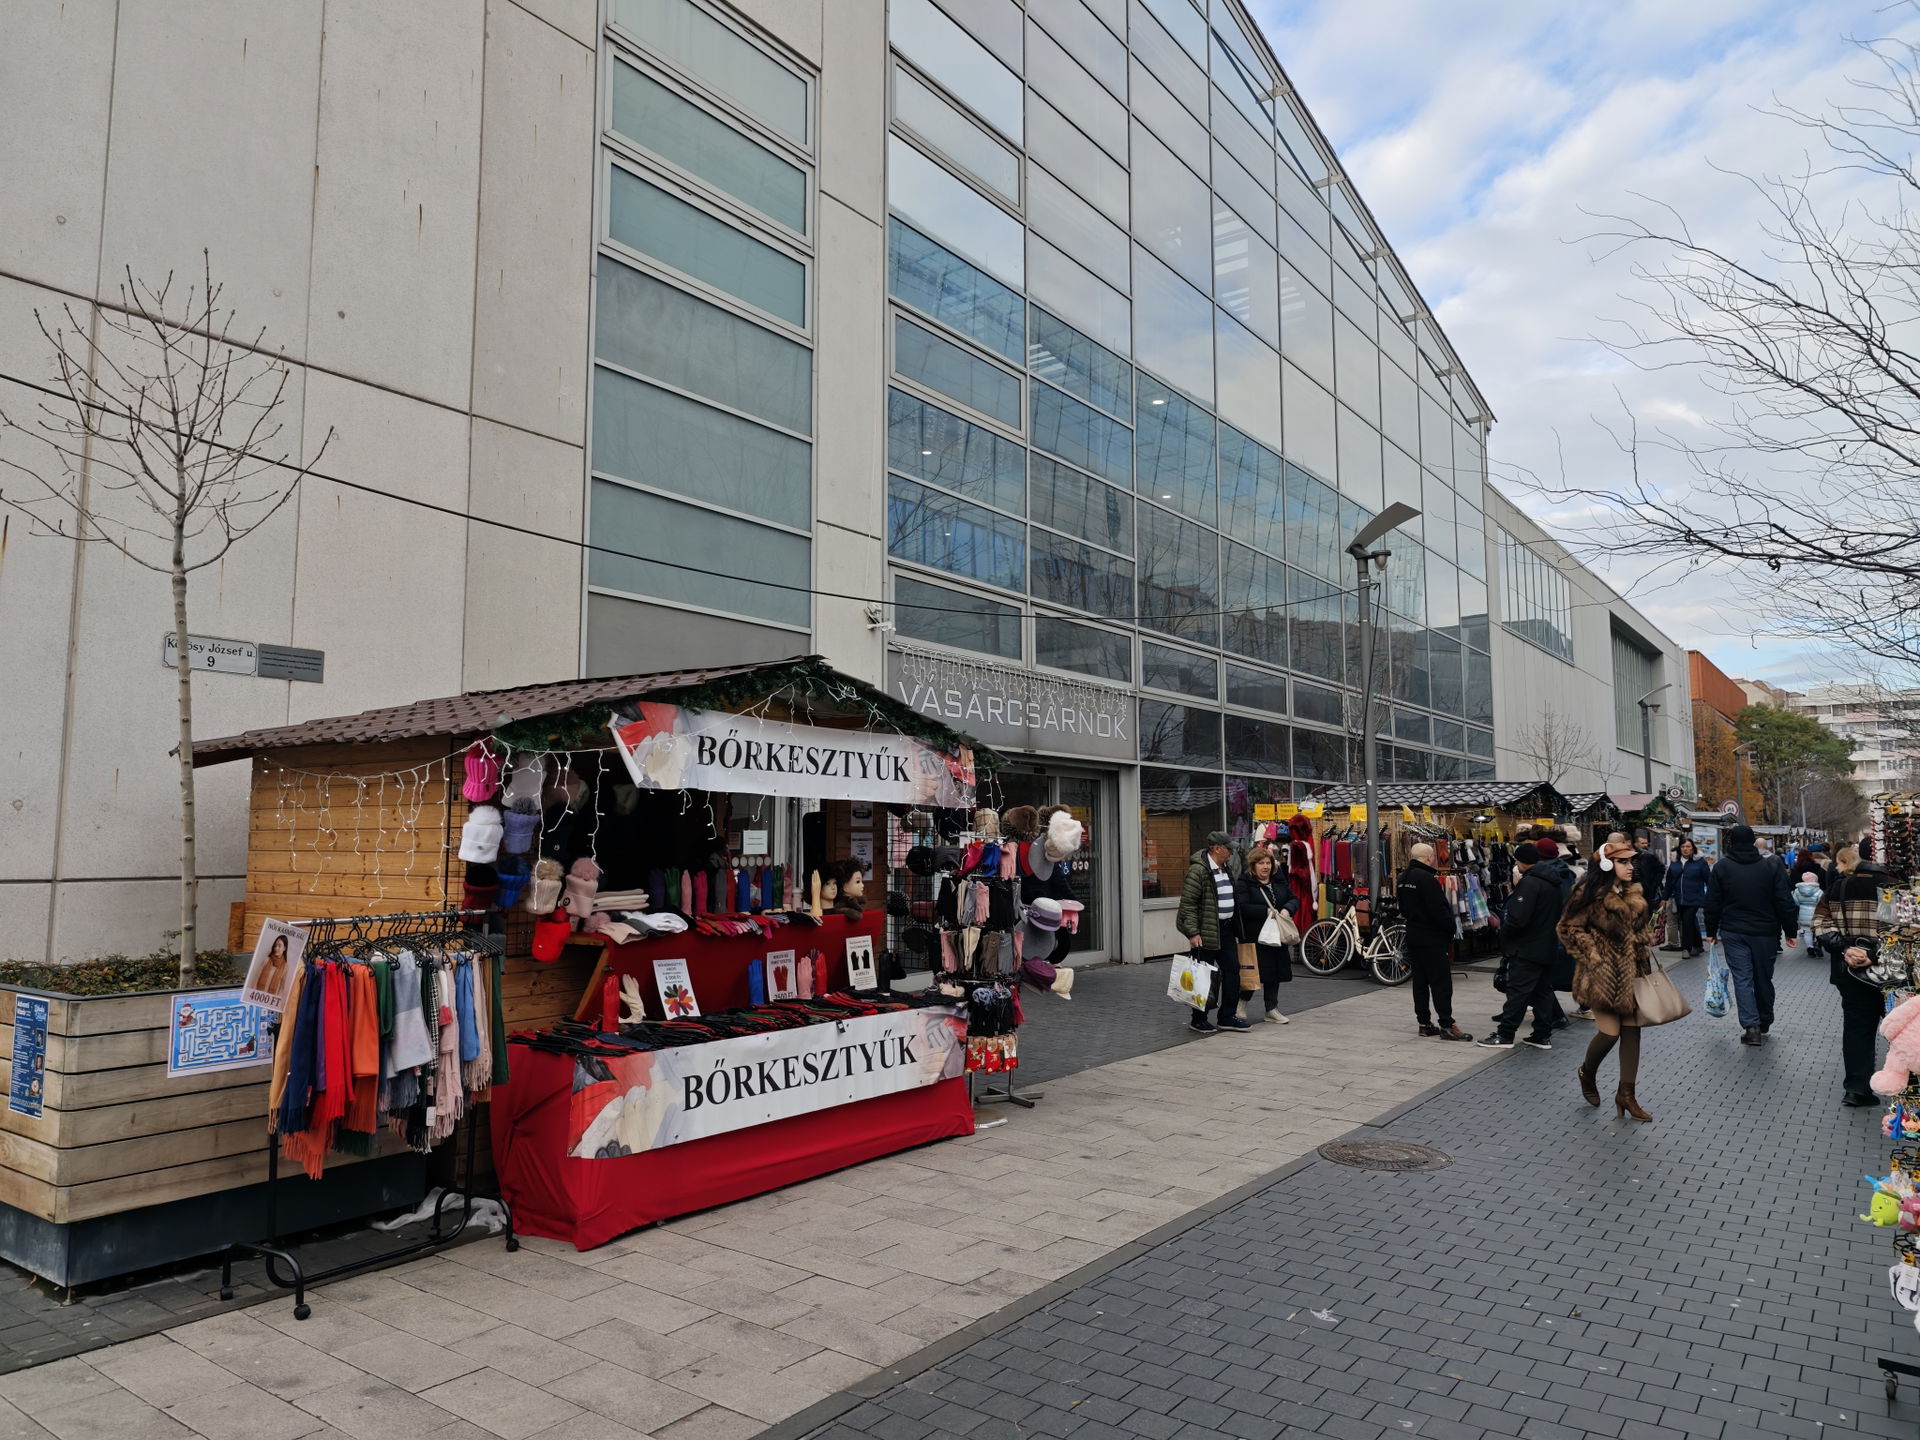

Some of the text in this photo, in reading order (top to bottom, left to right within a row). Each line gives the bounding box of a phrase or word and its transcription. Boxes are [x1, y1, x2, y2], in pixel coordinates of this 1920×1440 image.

[167, 638, 256, 658] Kösy József u.
[207, 655, 216, 668] 9
[697, 729, 912, 784] BŐRKESZTYŰK
[249, 991, 282, 1007] 4000 FT
[681, 1029, 918, 1112] BŐRKESZTYŰK
